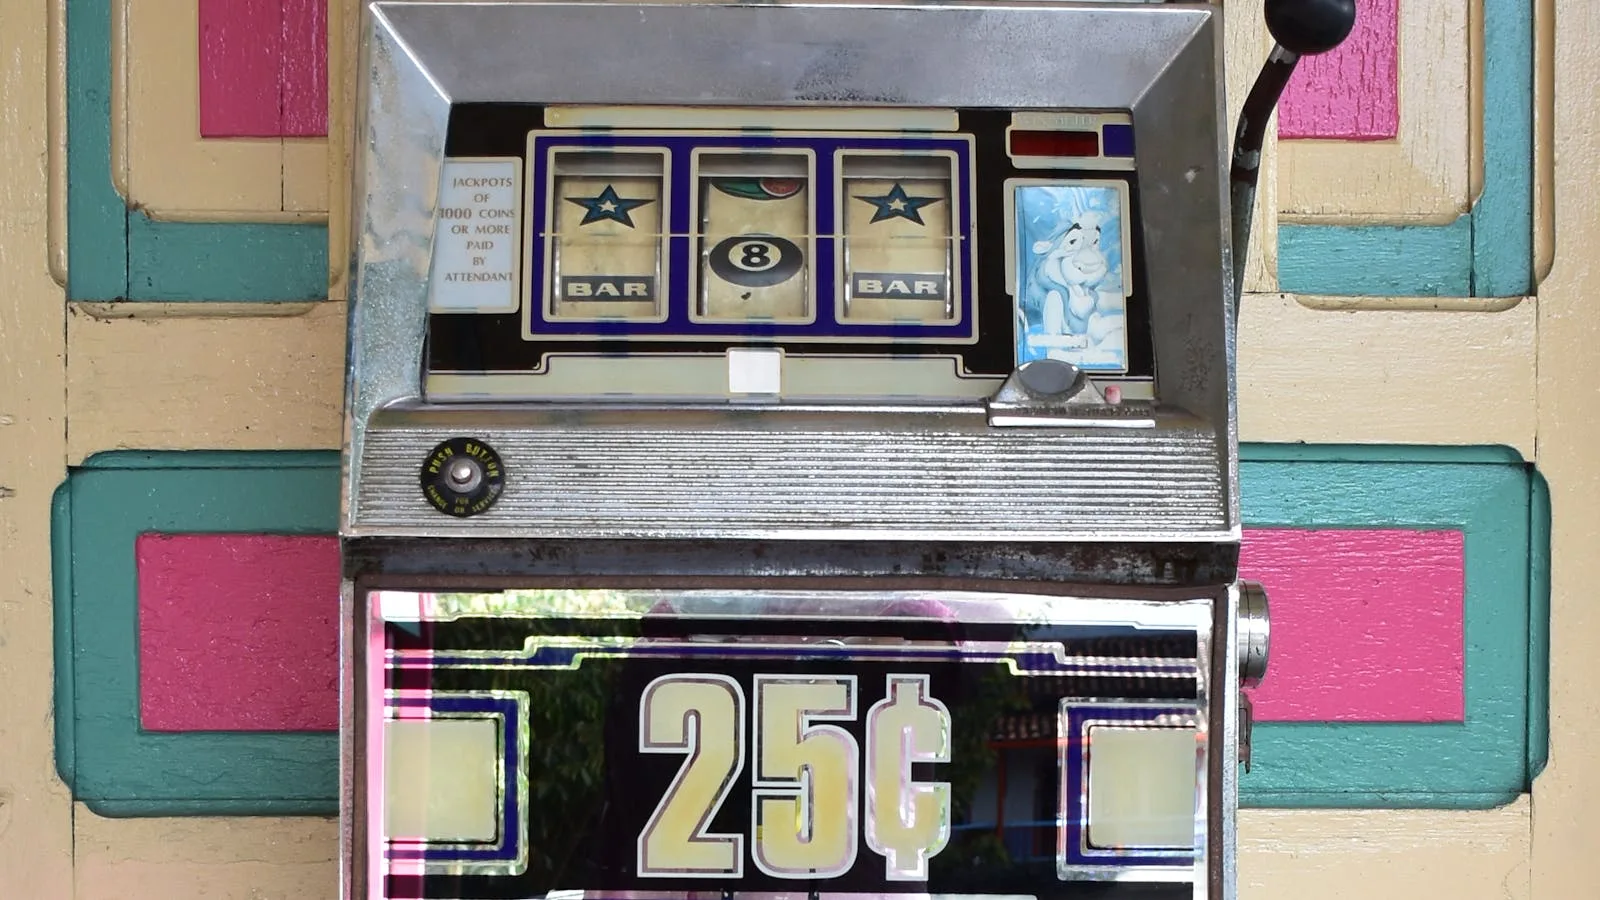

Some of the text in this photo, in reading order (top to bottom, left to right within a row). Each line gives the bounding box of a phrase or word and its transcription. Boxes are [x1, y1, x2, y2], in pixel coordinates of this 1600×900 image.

[453, 177, 513, 188] JACKPOTS
[473, 193, 490, 203] OF
[439, 207, 515, 219] 1000 COINS
[450, 224, 511, 234] OR MORE
[466, 240, 494, 250] PAID
[472, 256, 486, 266] BY
[740, 243, 771, 268] 8
[445, 271, 513, 281] ATTENDANT
[567, 282, 648, 297] BAR
[858, 279, 938, 295] BAR
[429, 443, 500, 478] PUSH BUTTON
[637, 673, 951, 882] 25¢
